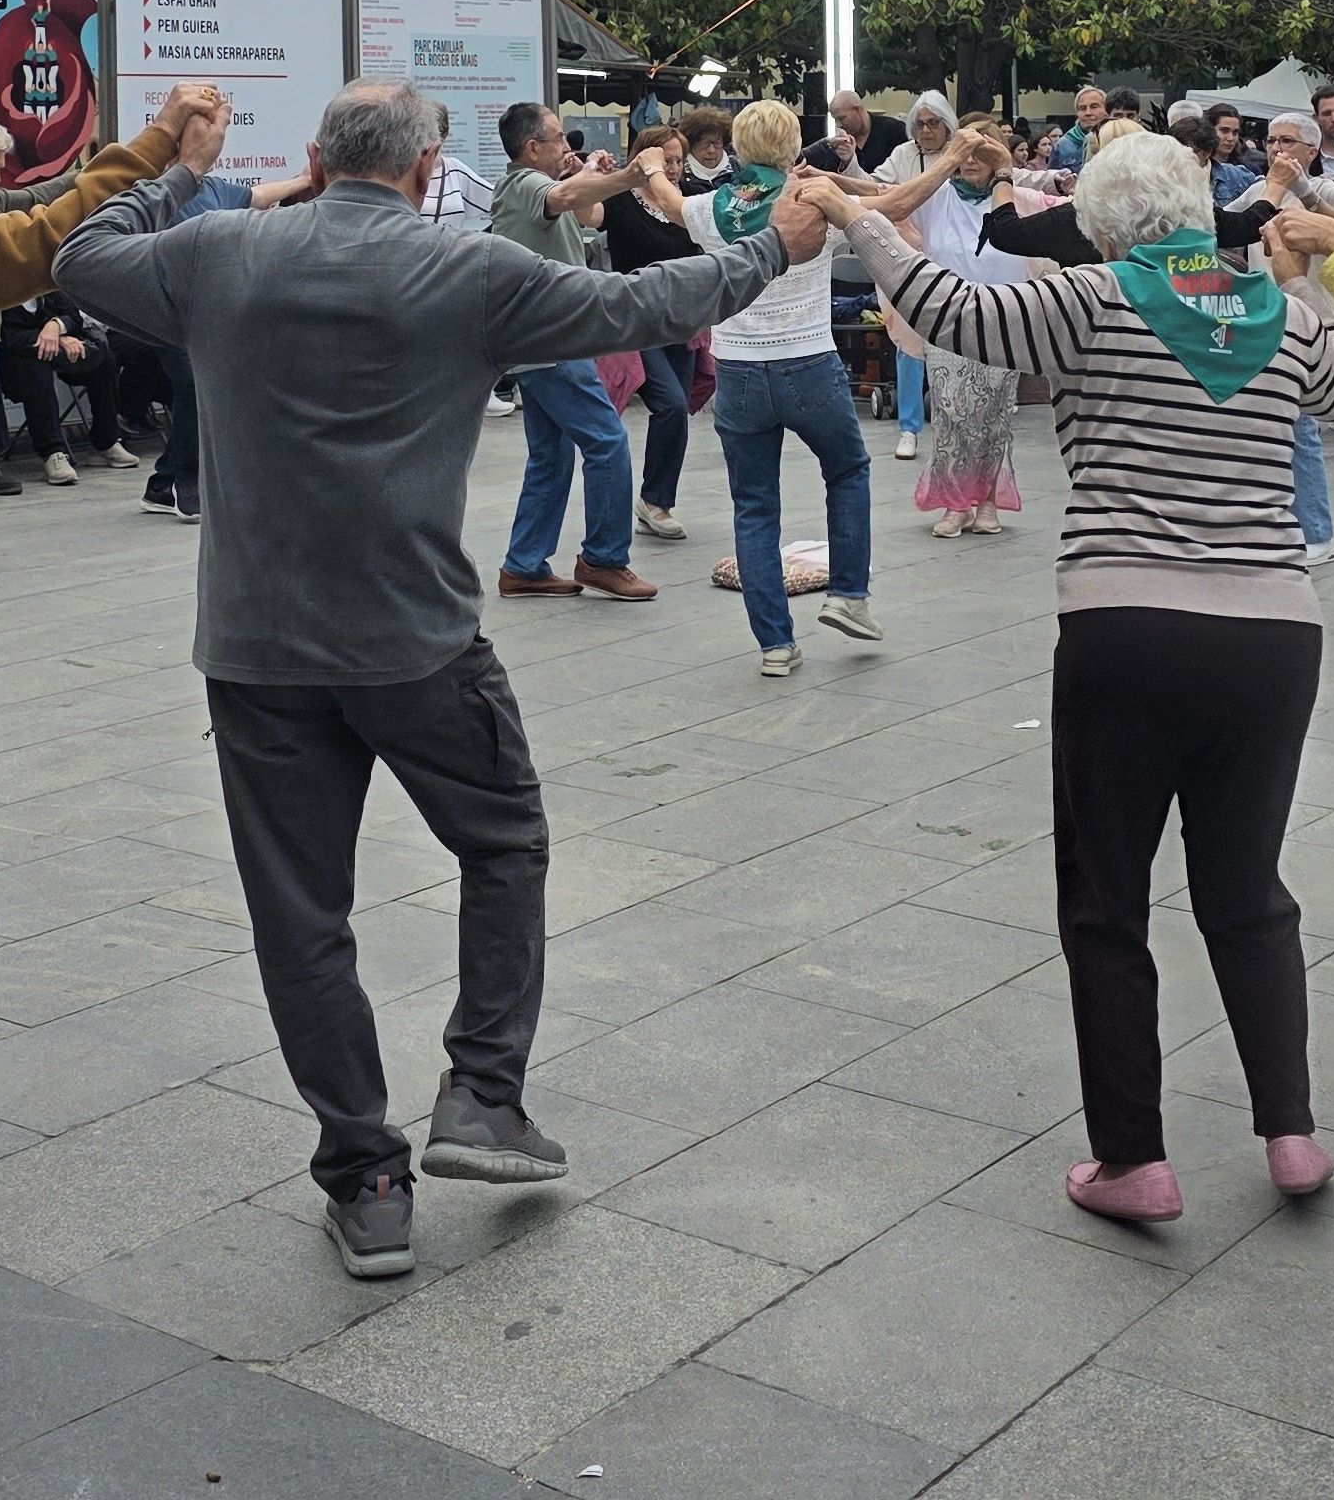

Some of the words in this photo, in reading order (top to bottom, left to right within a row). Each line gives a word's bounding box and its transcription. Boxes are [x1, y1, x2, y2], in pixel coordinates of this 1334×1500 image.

[158, 19, 180, 33] PEM
[183, 20, 219, 34] GUIERA
[158, 45, 191, 59] MASIA
[194, 46, 214, 59] CAN
[217, 47, 285, 61] SERRAPARERA
[414, 39, 431, 53] PARC
[415, 53, 427, 66] DEL
[451, 54, 459, 67] DE
[233, 113, 255, 125] DIES
[226, 158, 231, 169] 2
[233, 155, 253, 168] MATÍ
[255, 157, 258, 168] I
[261, 156, 287, 168] TARDA
[1167, 253, 1219, 275] Festes
[1201, 295, 1246, 317] MAIG
